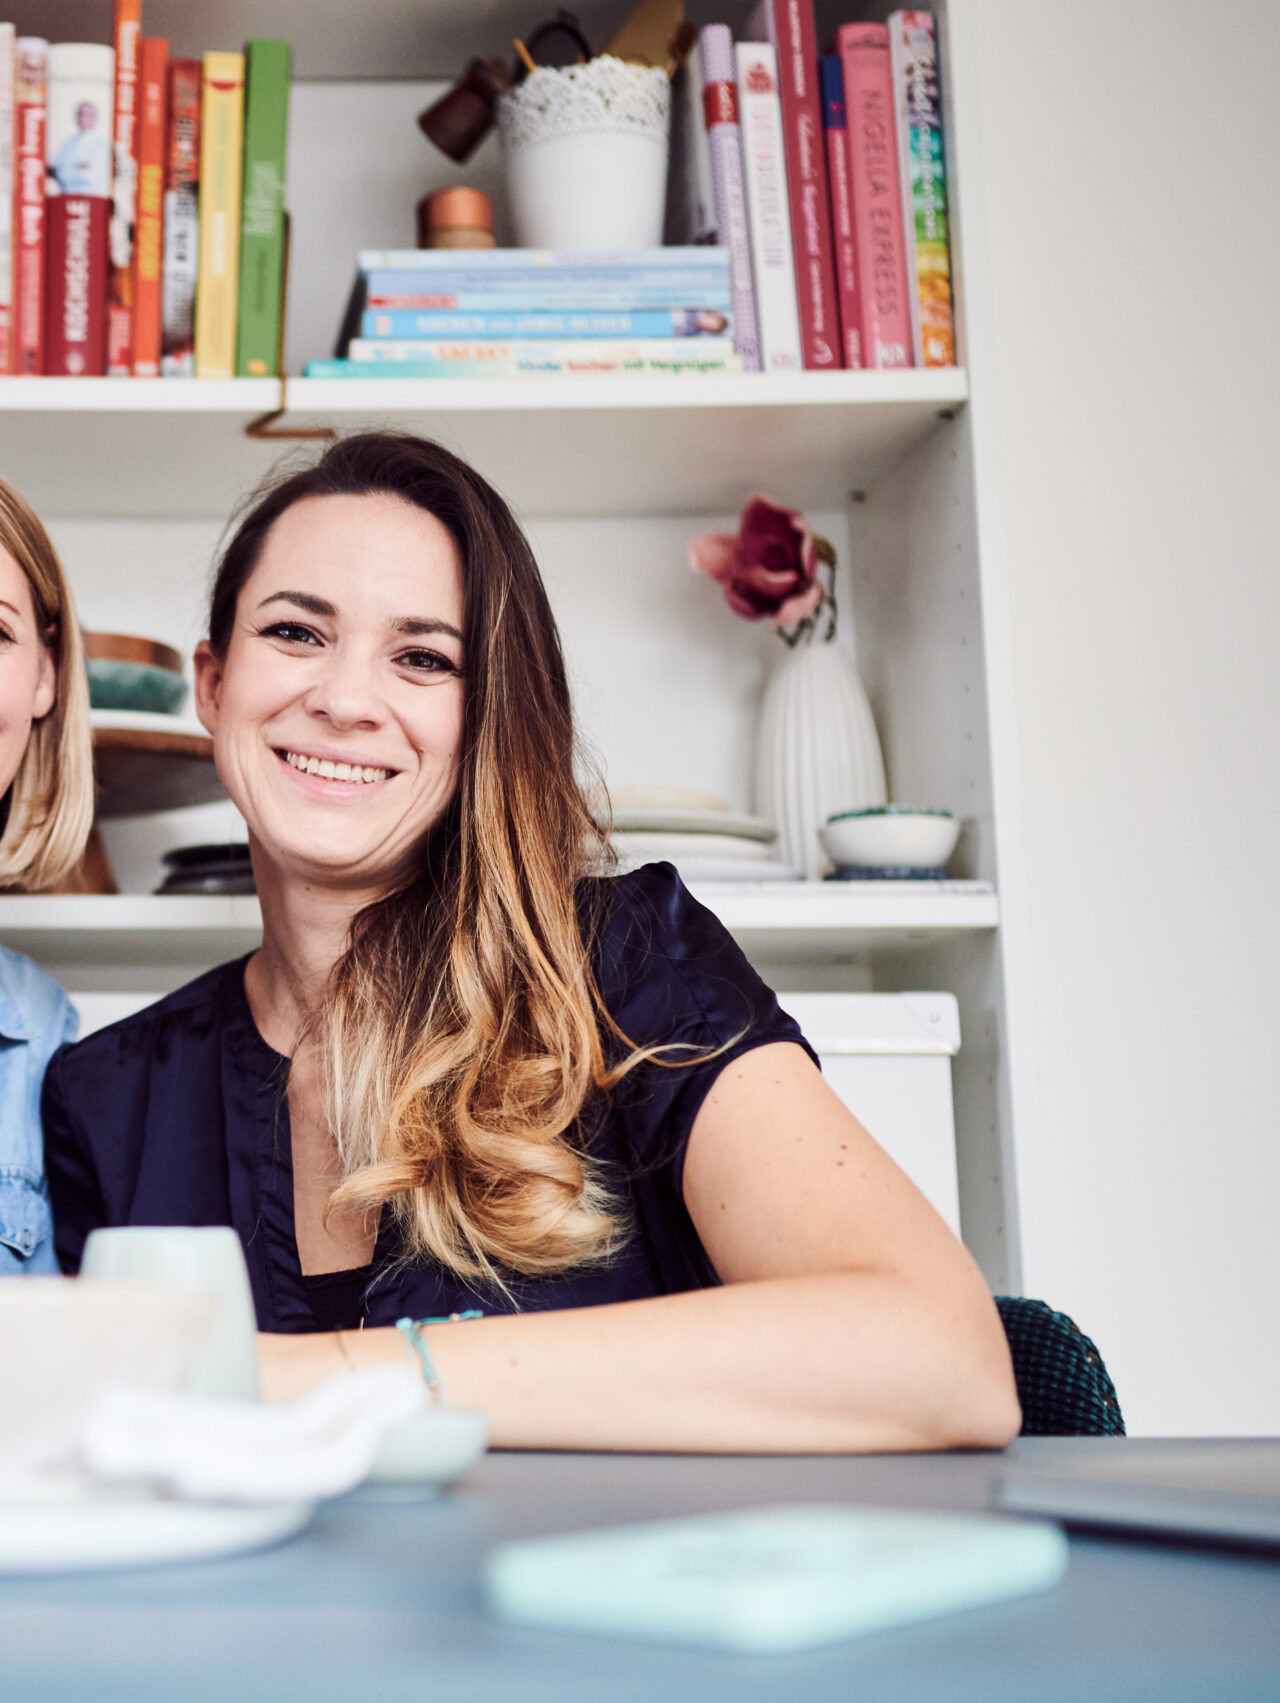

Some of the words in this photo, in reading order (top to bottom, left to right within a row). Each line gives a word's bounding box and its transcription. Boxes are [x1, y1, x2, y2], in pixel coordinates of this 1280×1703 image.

[861, 88, 889, 199] NIGELLA
[64, 199, 90, 343] KOCHSCHULE
[870, 207, 899, 317] EXPRESS
